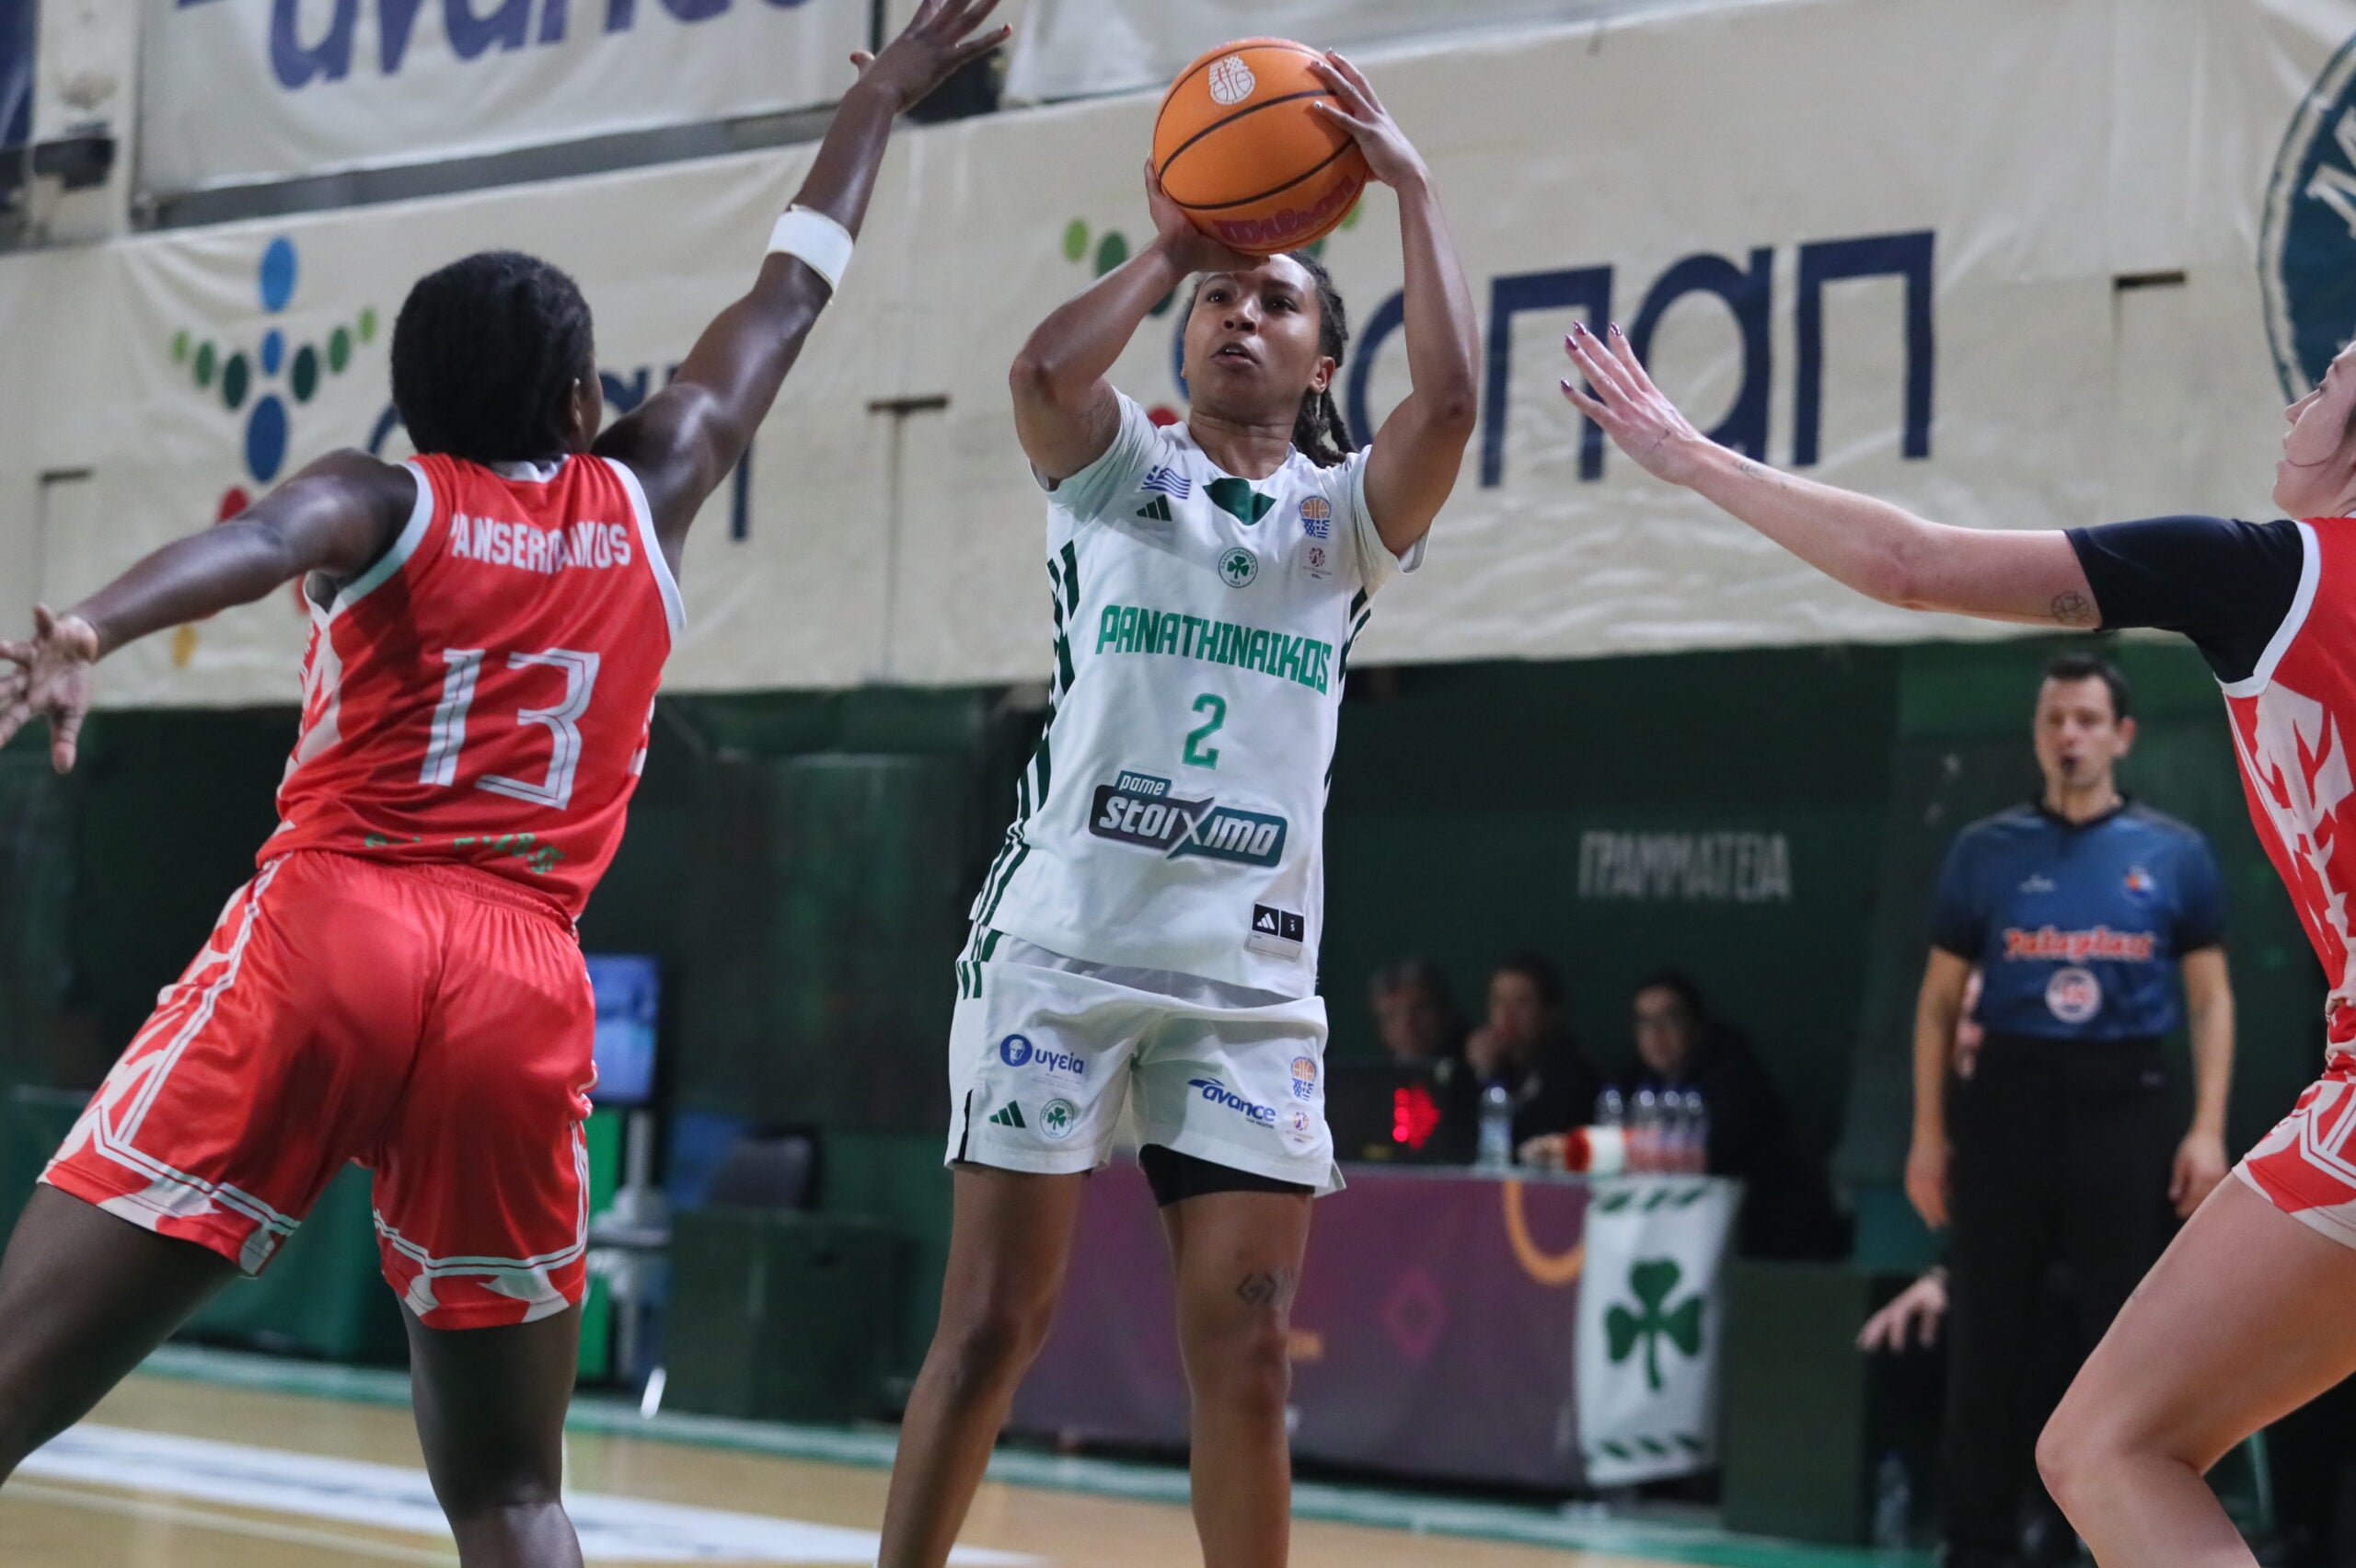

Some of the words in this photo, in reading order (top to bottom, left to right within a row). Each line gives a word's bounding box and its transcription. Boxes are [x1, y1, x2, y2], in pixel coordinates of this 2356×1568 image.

[1095, 605, 1333, 696] PANATHINAIKOS
[419, 647, 600, 812] 13
[1182, 693, 1228, 770] 2
[1118, 774, 1166, 797] pame
[1202, 1085, 1276, 1122] avance
